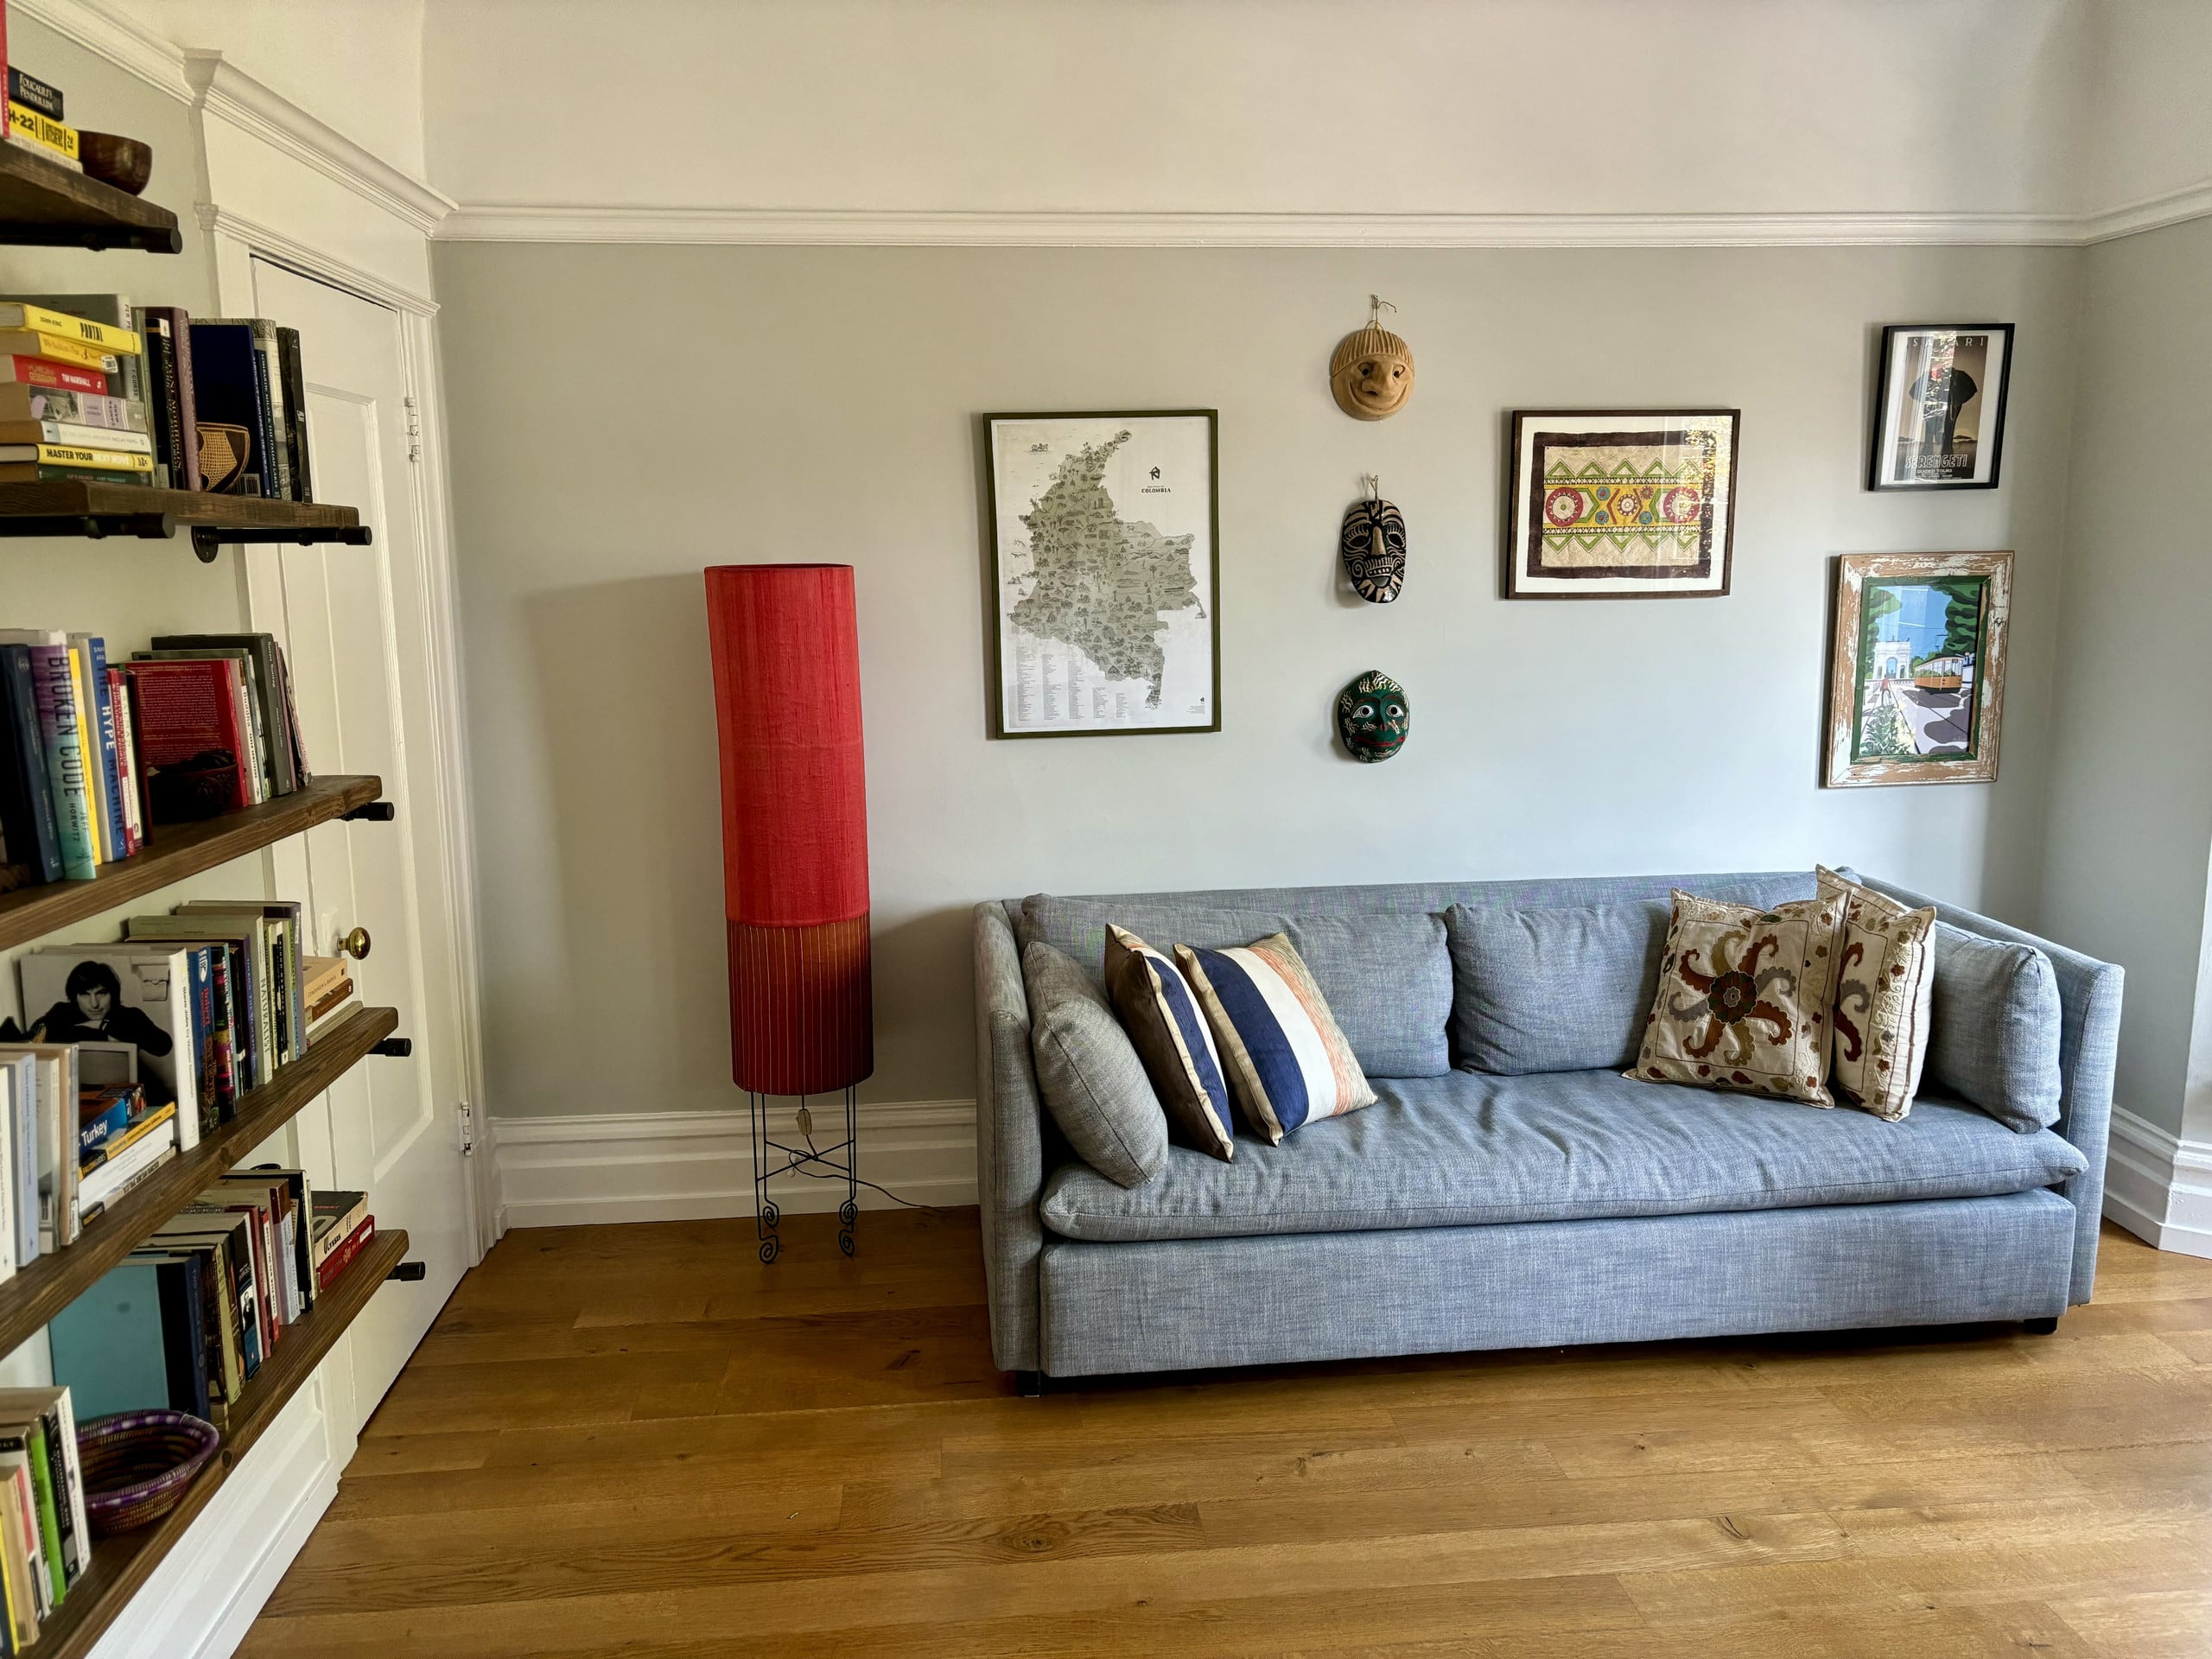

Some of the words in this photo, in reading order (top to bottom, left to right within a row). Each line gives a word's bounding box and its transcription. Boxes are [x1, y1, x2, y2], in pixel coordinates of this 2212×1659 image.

[79, 322, 104, 342] PORTAL
[46, 448, 74, 460] MASTER
[74, 450, 93, 461] YOUR
[1904, 454, 1968, 468] SERENGETI
[48, 657, 79, 736] BROKEN
[60, 746, 86, 797] CODE
[102, 706, 116, 750] HYPE
[109, 760, 124, 836] MACHINE
[69, 803, 80, 842] HORWITZ
[260, 978, 270, 1052] NATURALIST
[81, 1120, 108, 1147] Turkey
